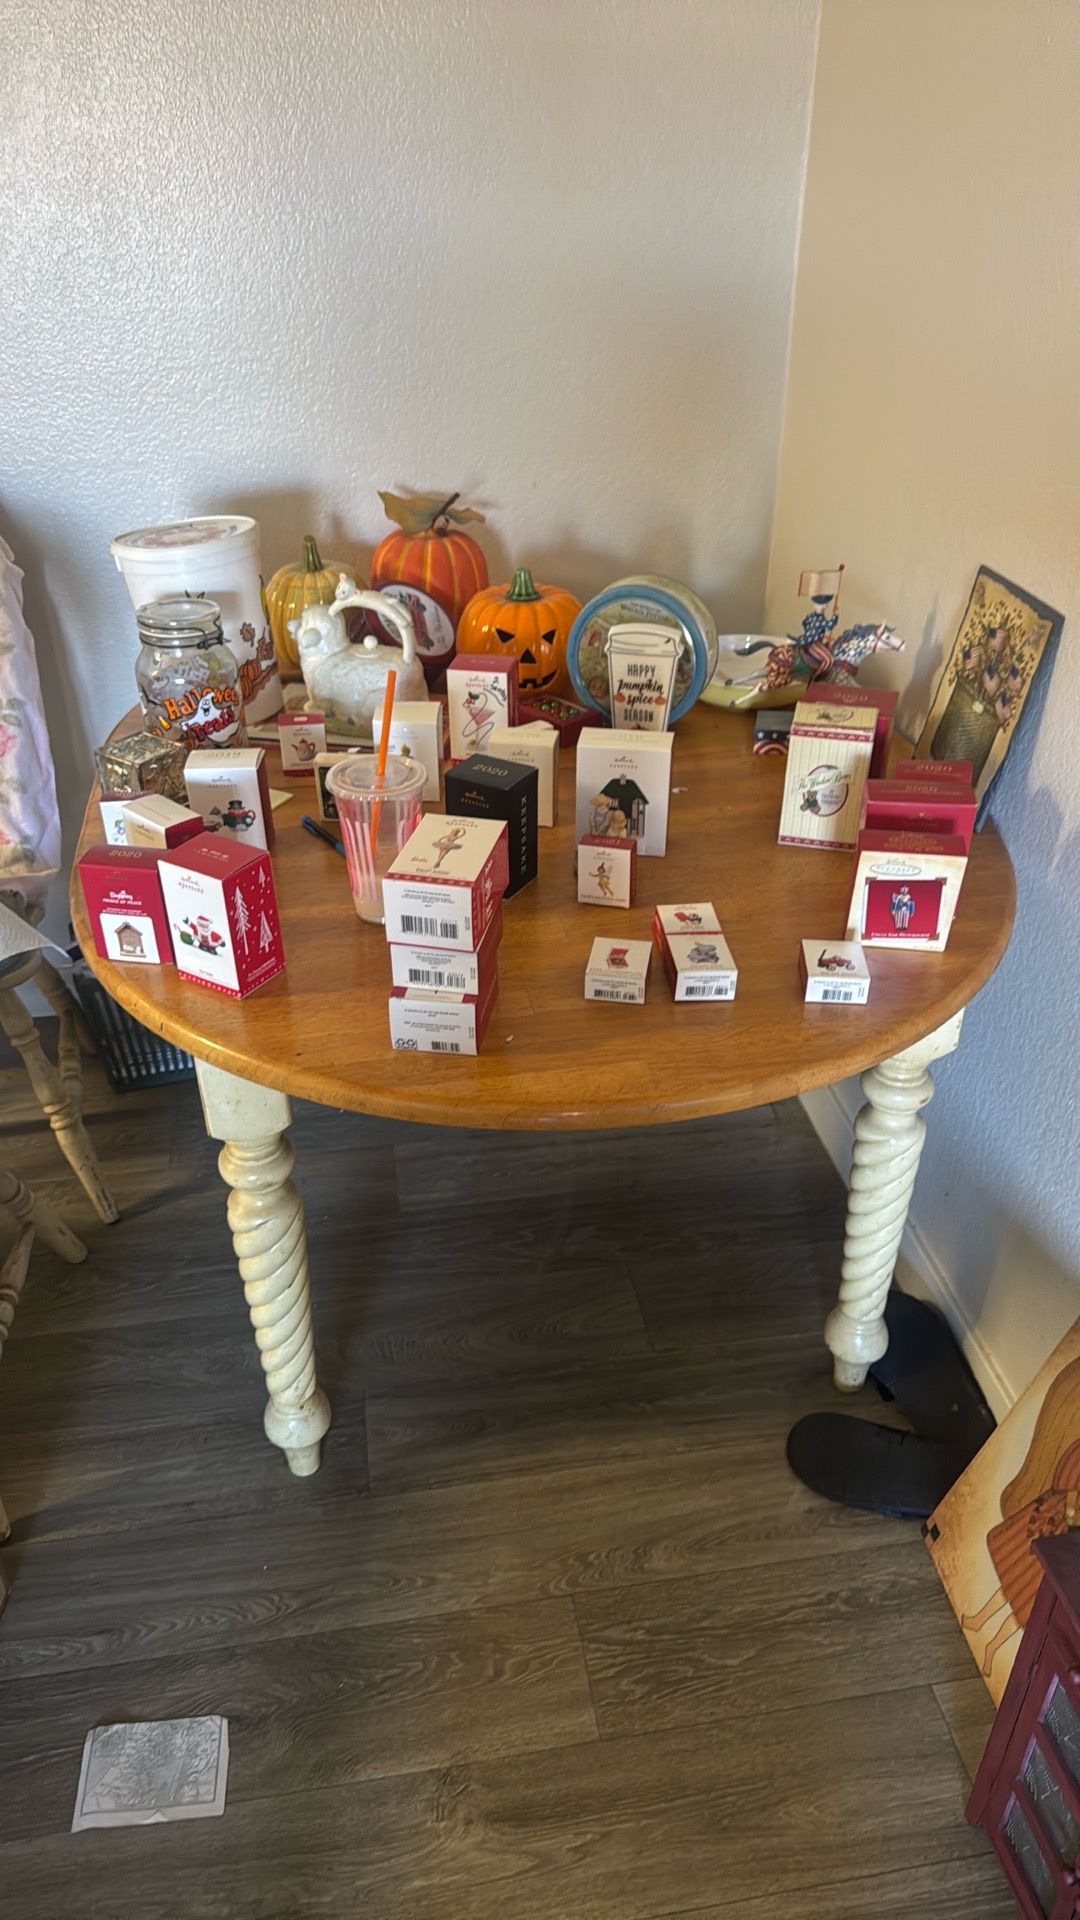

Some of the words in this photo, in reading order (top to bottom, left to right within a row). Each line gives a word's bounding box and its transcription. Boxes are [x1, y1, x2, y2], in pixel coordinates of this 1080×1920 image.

[627, 663, 656, 678] HAPPY
[617, 678, 664, 695] pumpkin
[626, 693, 654, 711] spice
[624, 708, 654, 723] SEASON
[472, 763, 509, 777] 2020
